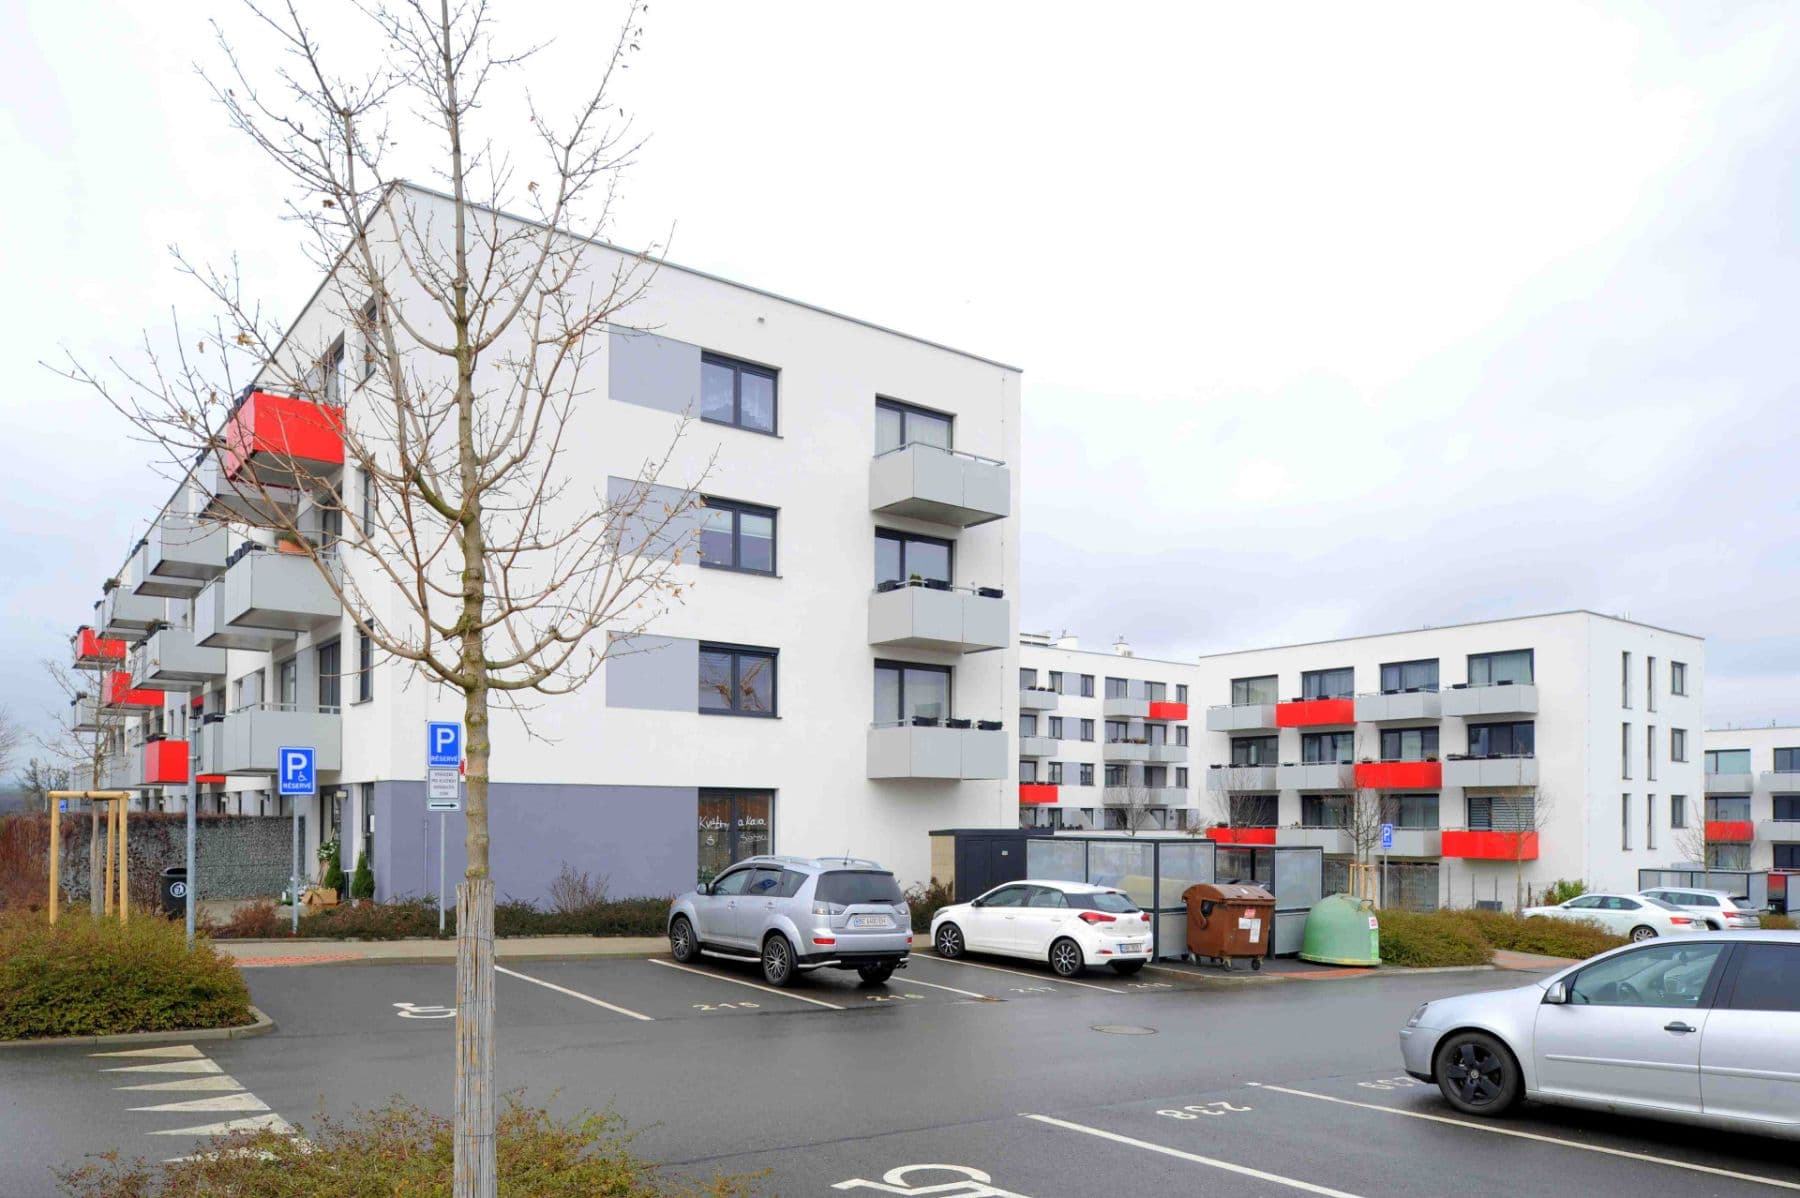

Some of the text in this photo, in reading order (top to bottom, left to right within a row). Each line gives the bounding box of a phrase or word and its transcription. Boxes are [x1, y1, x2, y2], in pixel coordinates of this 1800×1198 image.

[436, 728, 455, 753] P
[287, 752, 307, 780] P
[1383, 827, 1390, 842] P
[1156, 1101, 1253, 1120] 238
